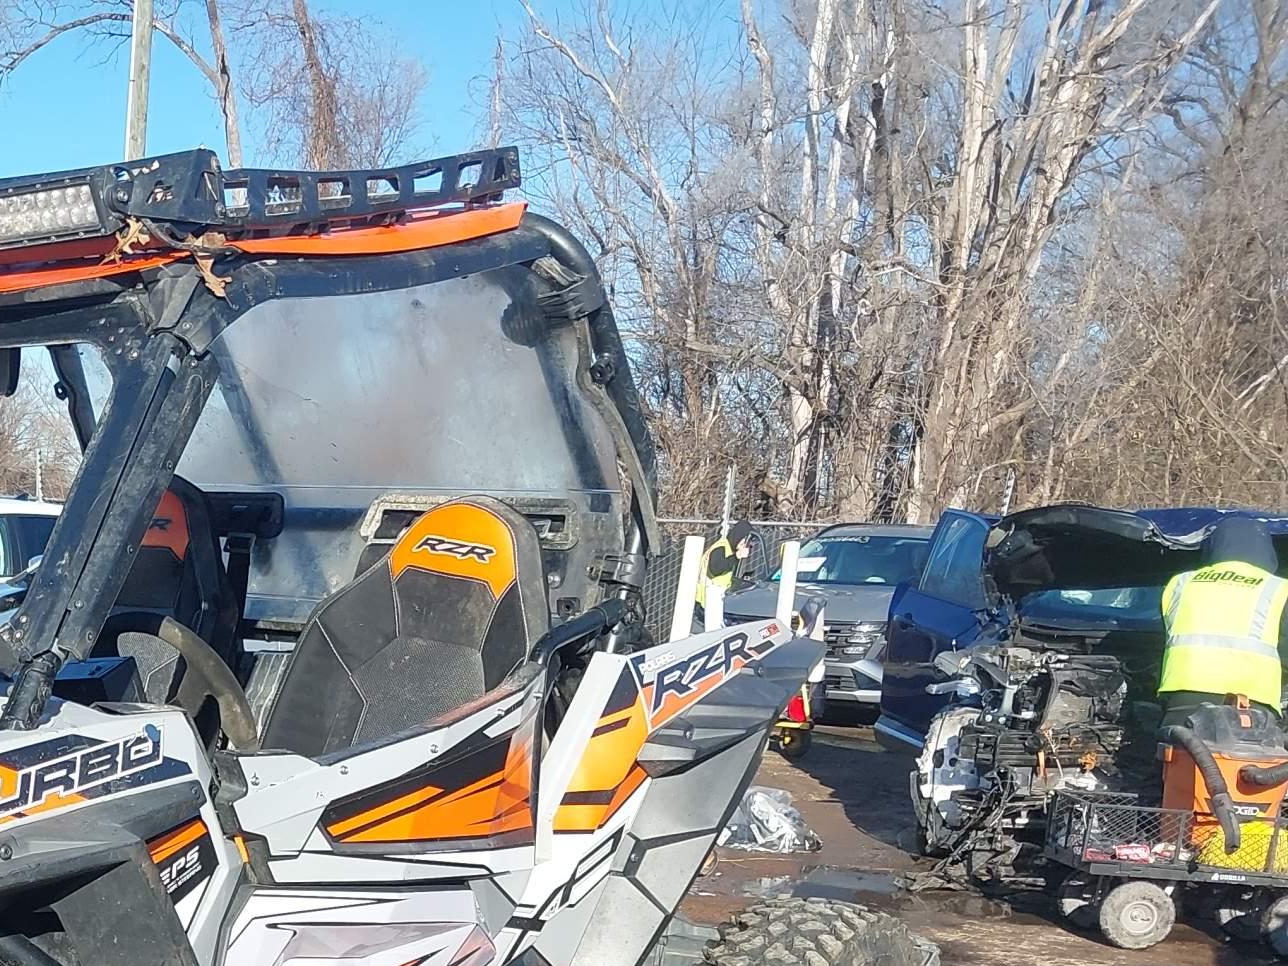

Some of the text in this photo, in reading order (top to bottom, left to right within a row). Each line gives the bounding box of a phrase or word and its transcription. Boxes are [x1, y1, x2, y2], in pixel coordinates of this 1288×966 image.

[413, 535, 496, 563] RZR
[1192, 570, 1263, 585] BigDeal
[651, 631, 755, 715] RZR
[159, 845, 200, 885] EPS
